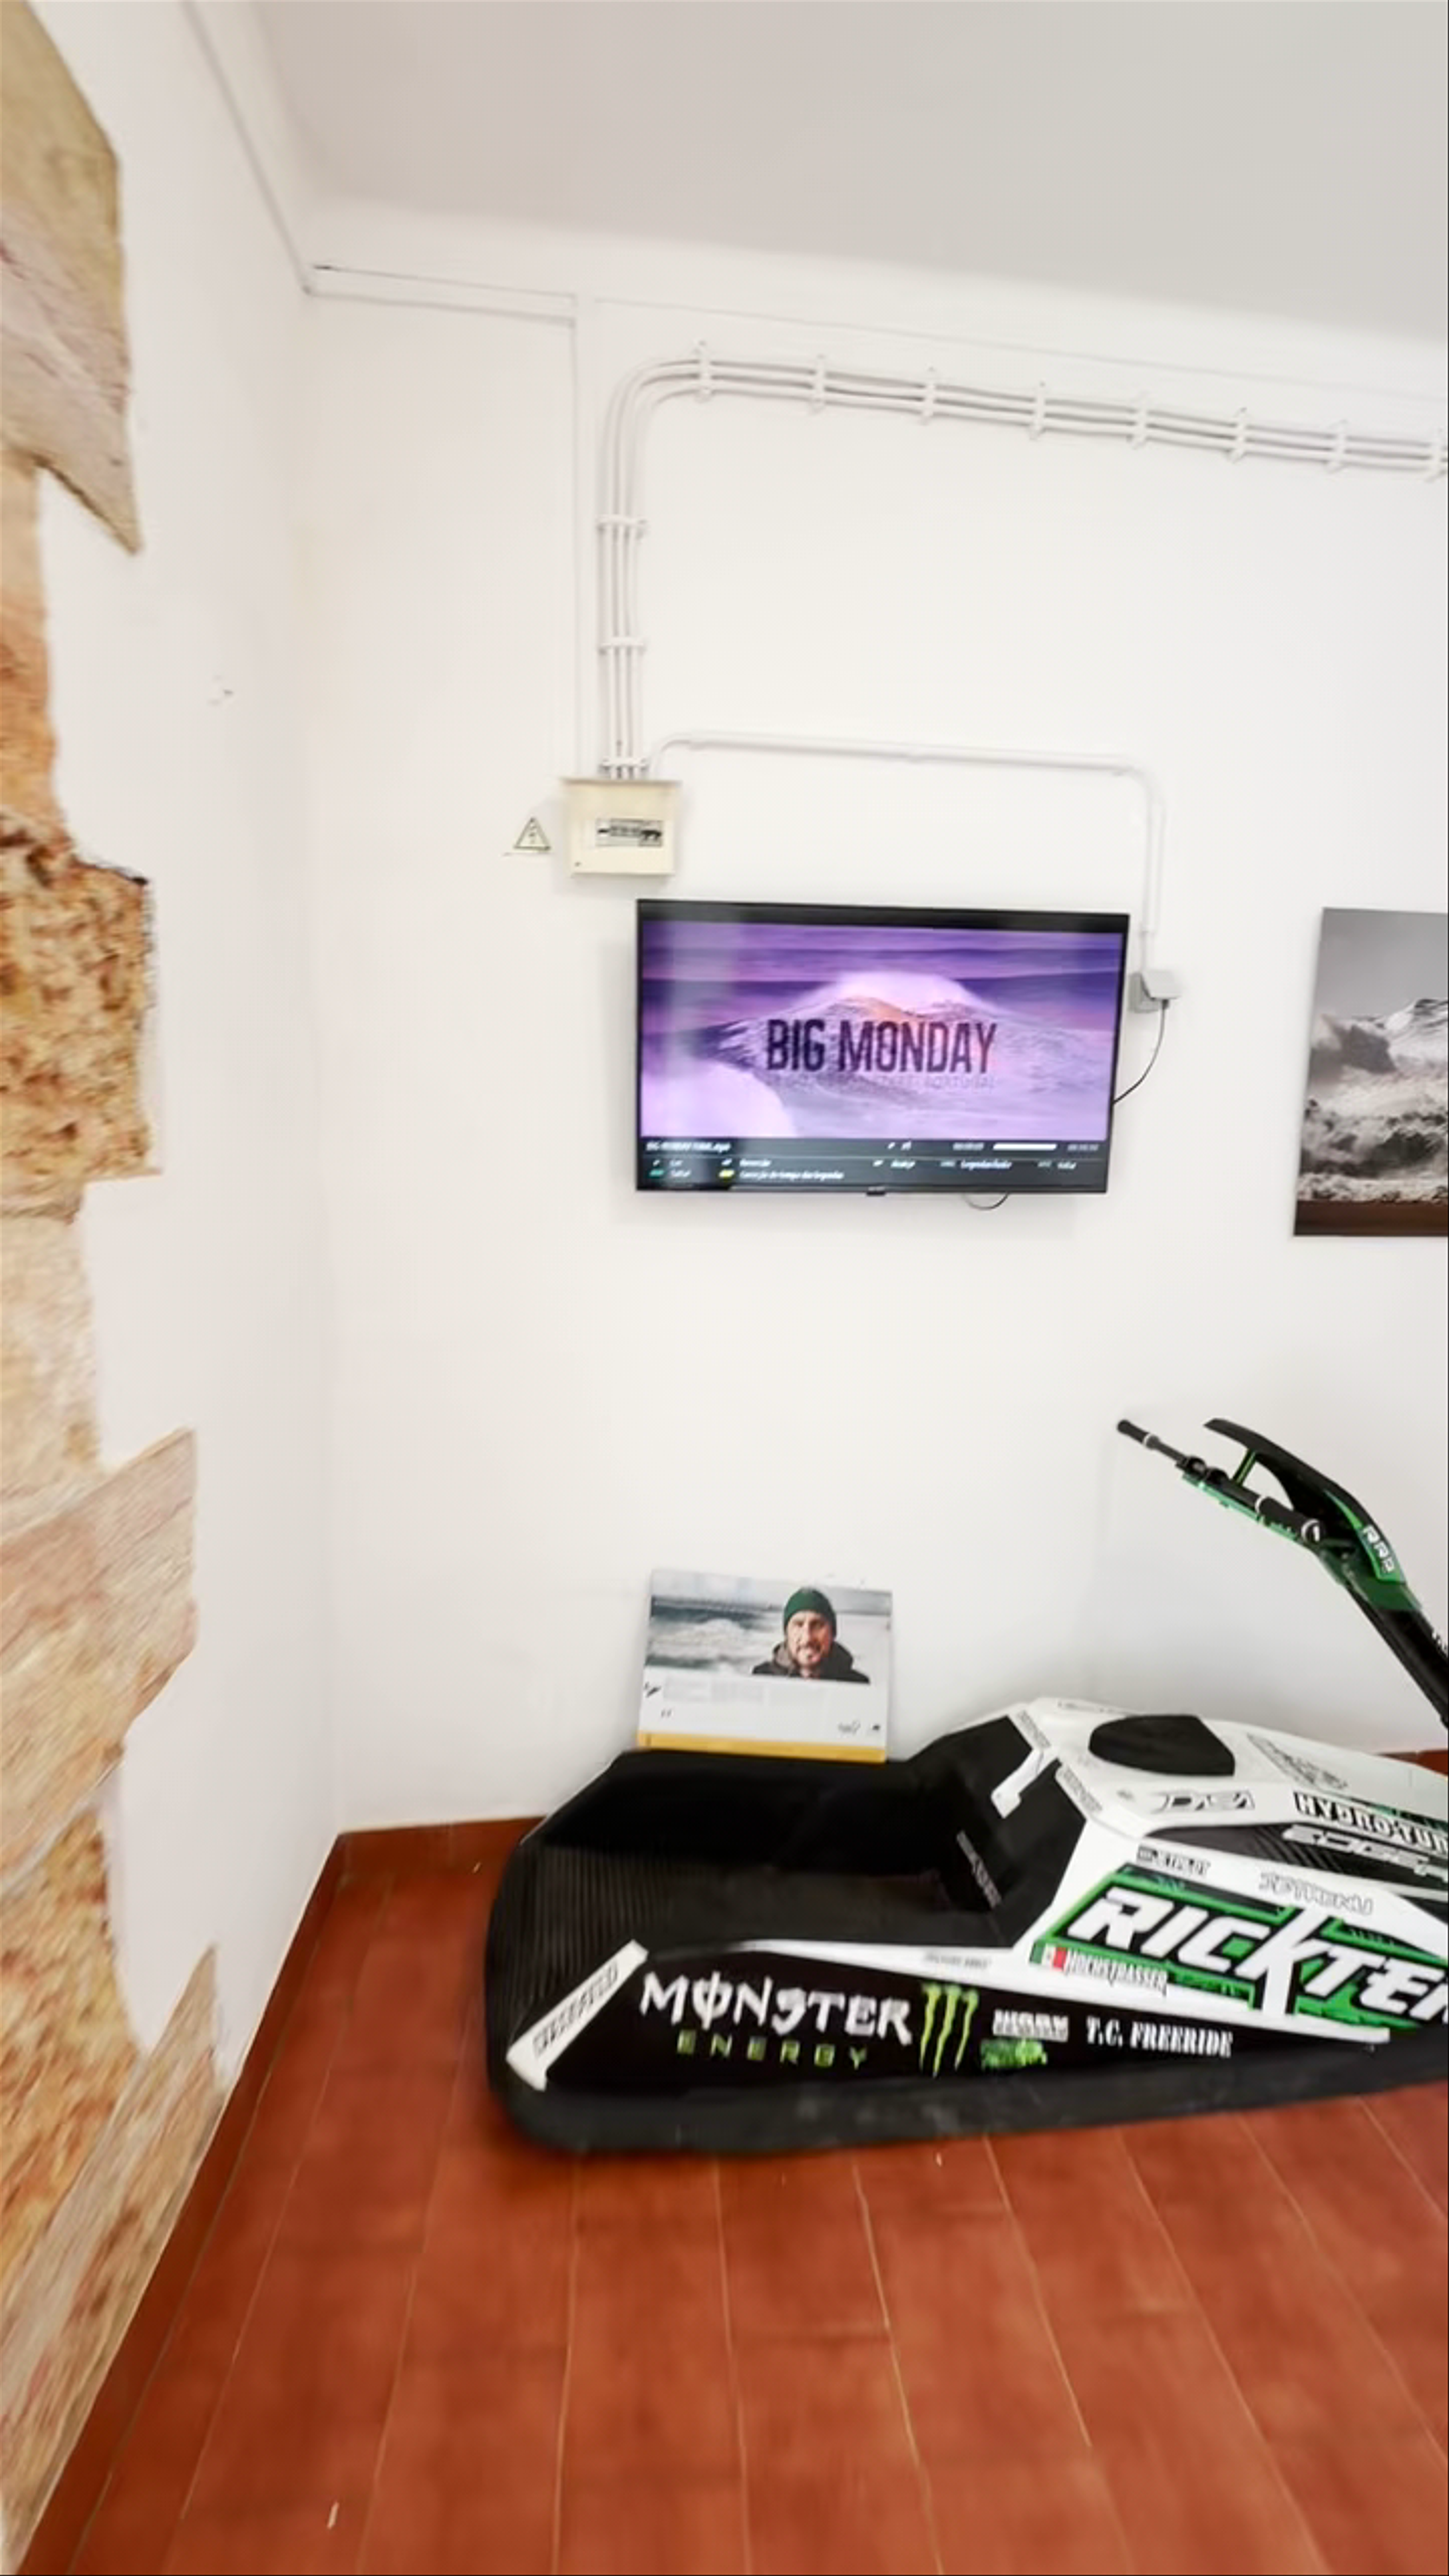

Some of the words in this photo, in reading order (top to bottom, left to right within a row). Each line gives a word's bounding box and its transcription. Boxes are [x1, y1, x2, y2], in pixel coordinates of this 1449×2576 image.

[767, 1018, 826, 1072] BIG
[837, 1020, 997, 1074] MONDAY
[639, 1970, 913, 2046] MONSTER
[677, 2029, 867, 2070] ENERGY
